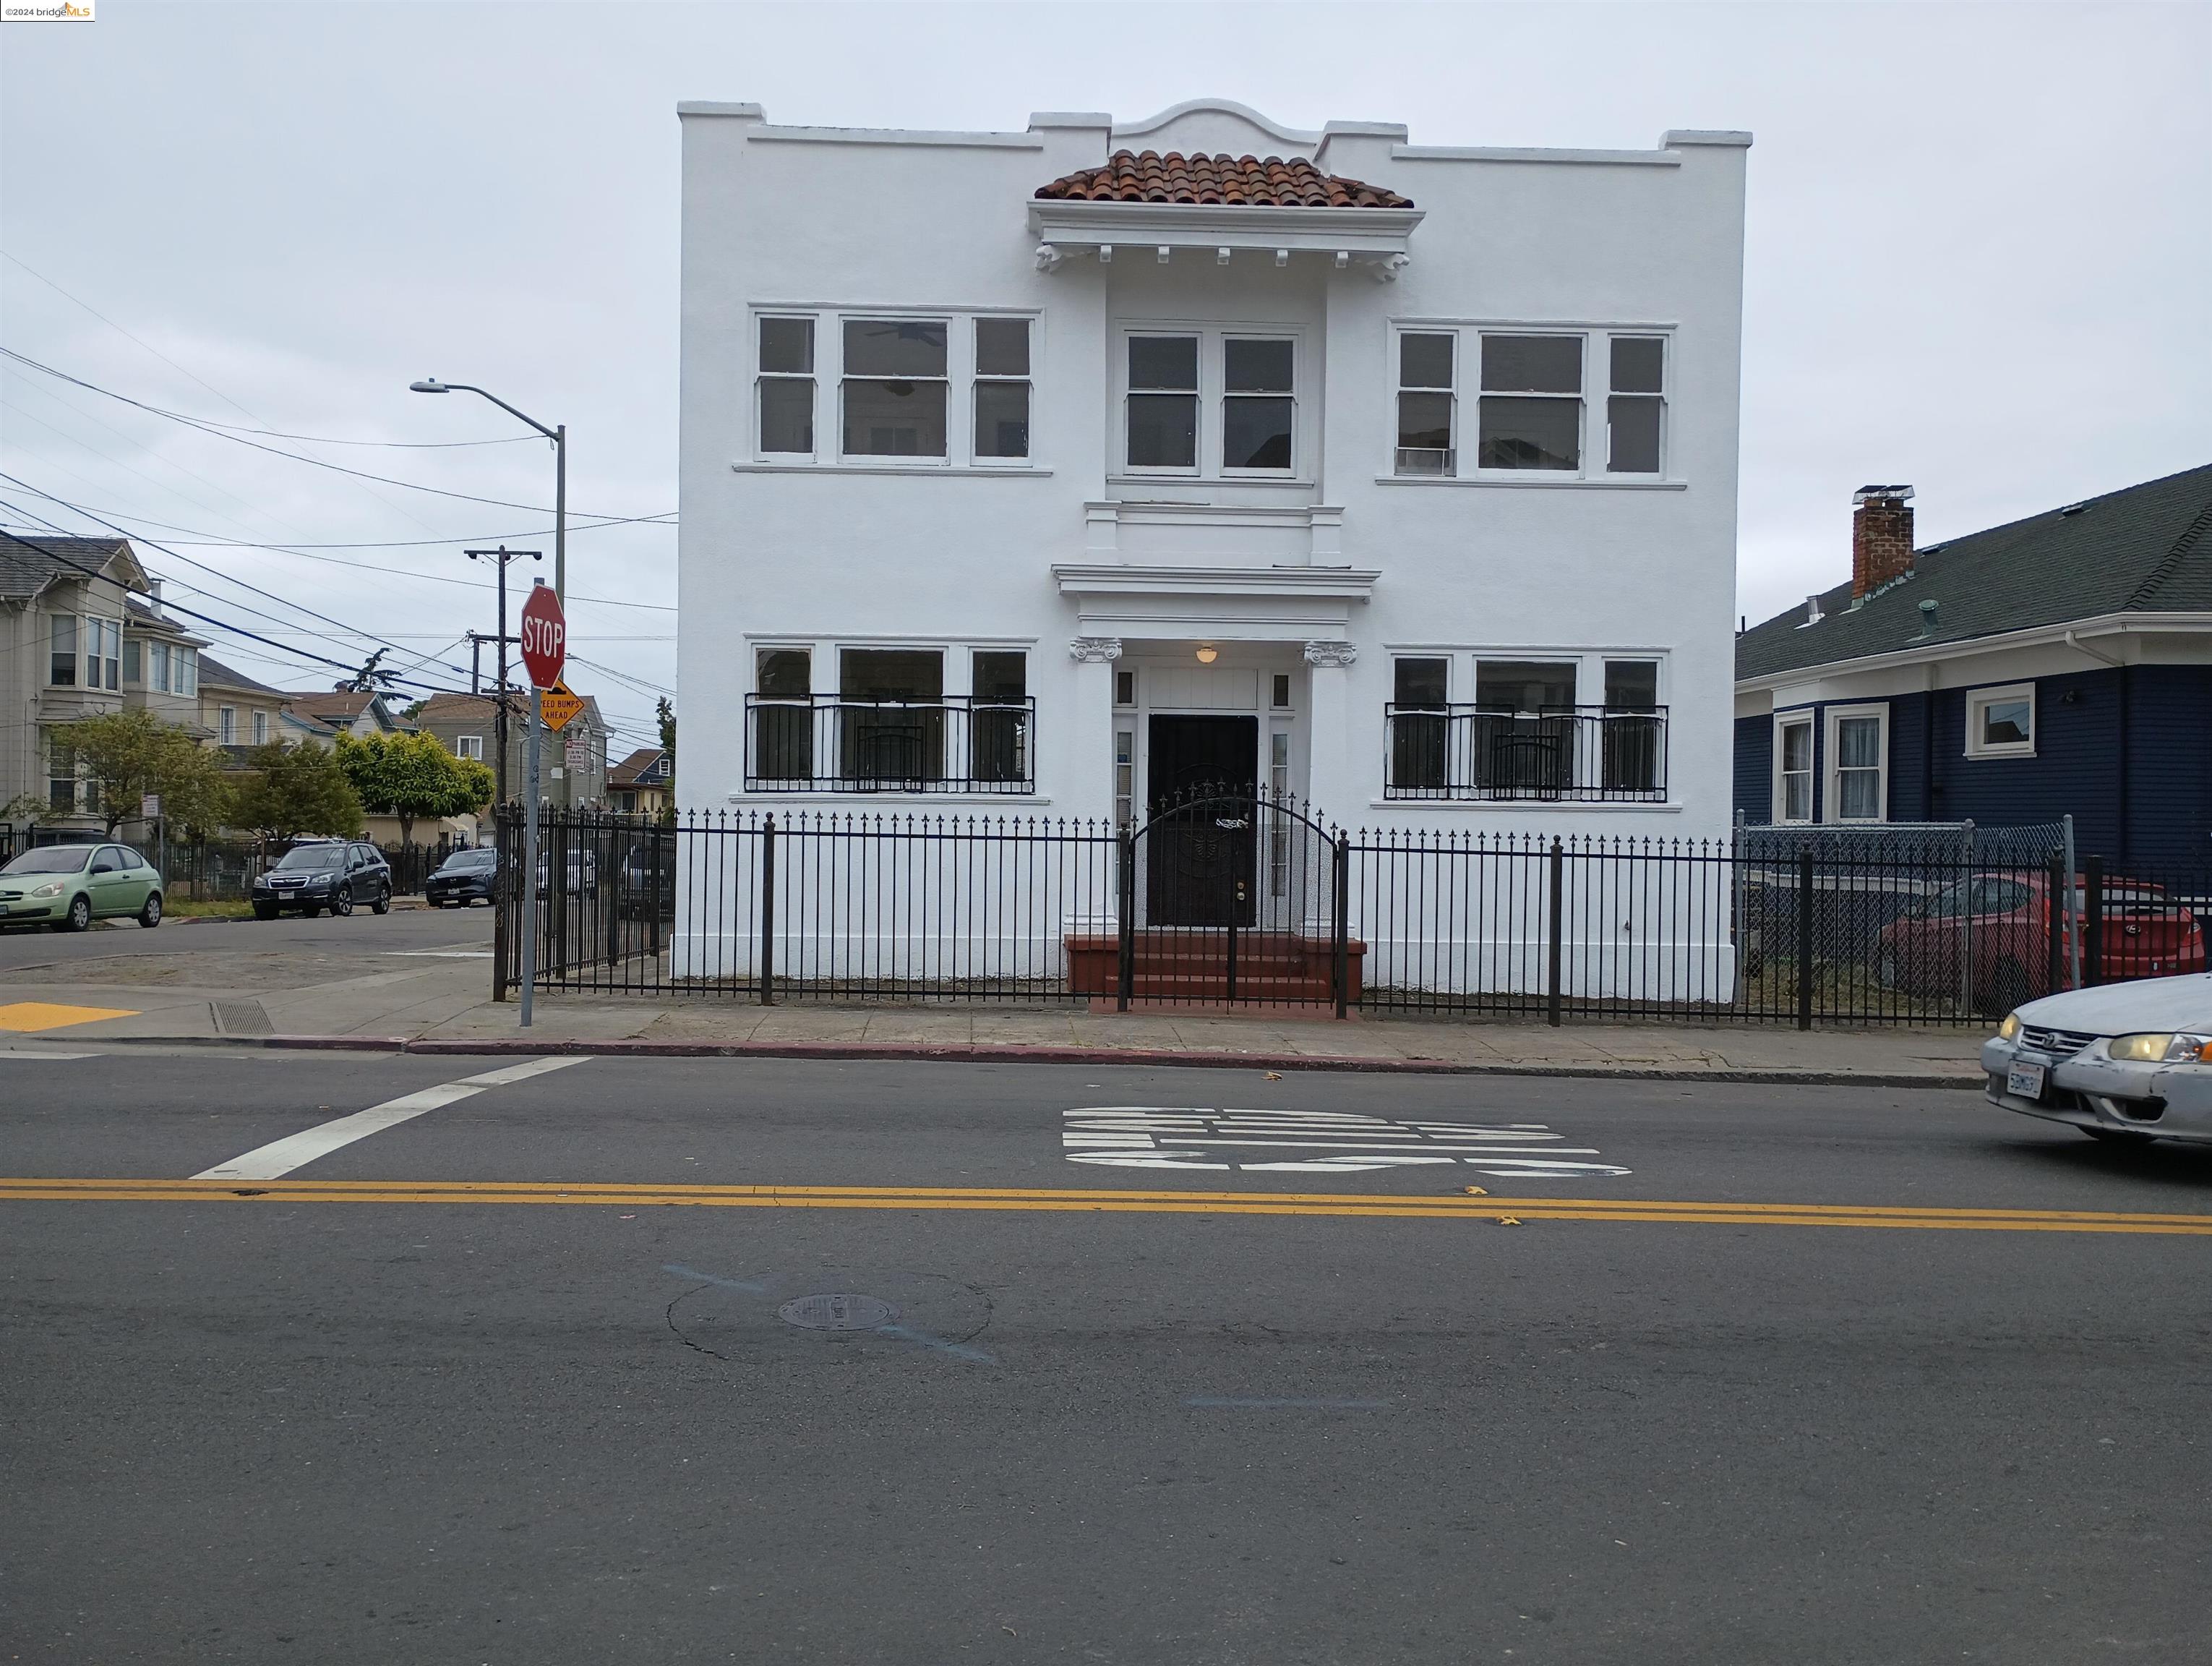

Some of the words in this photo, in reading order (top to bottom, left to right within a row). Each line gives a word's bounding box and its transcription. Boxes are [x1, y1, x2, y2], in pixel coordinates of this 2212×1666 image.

[524, 615, 563, 658] STOP
[541, 699, 554, 708] EED
[1063, 1106, 1631, 1177] STOP
